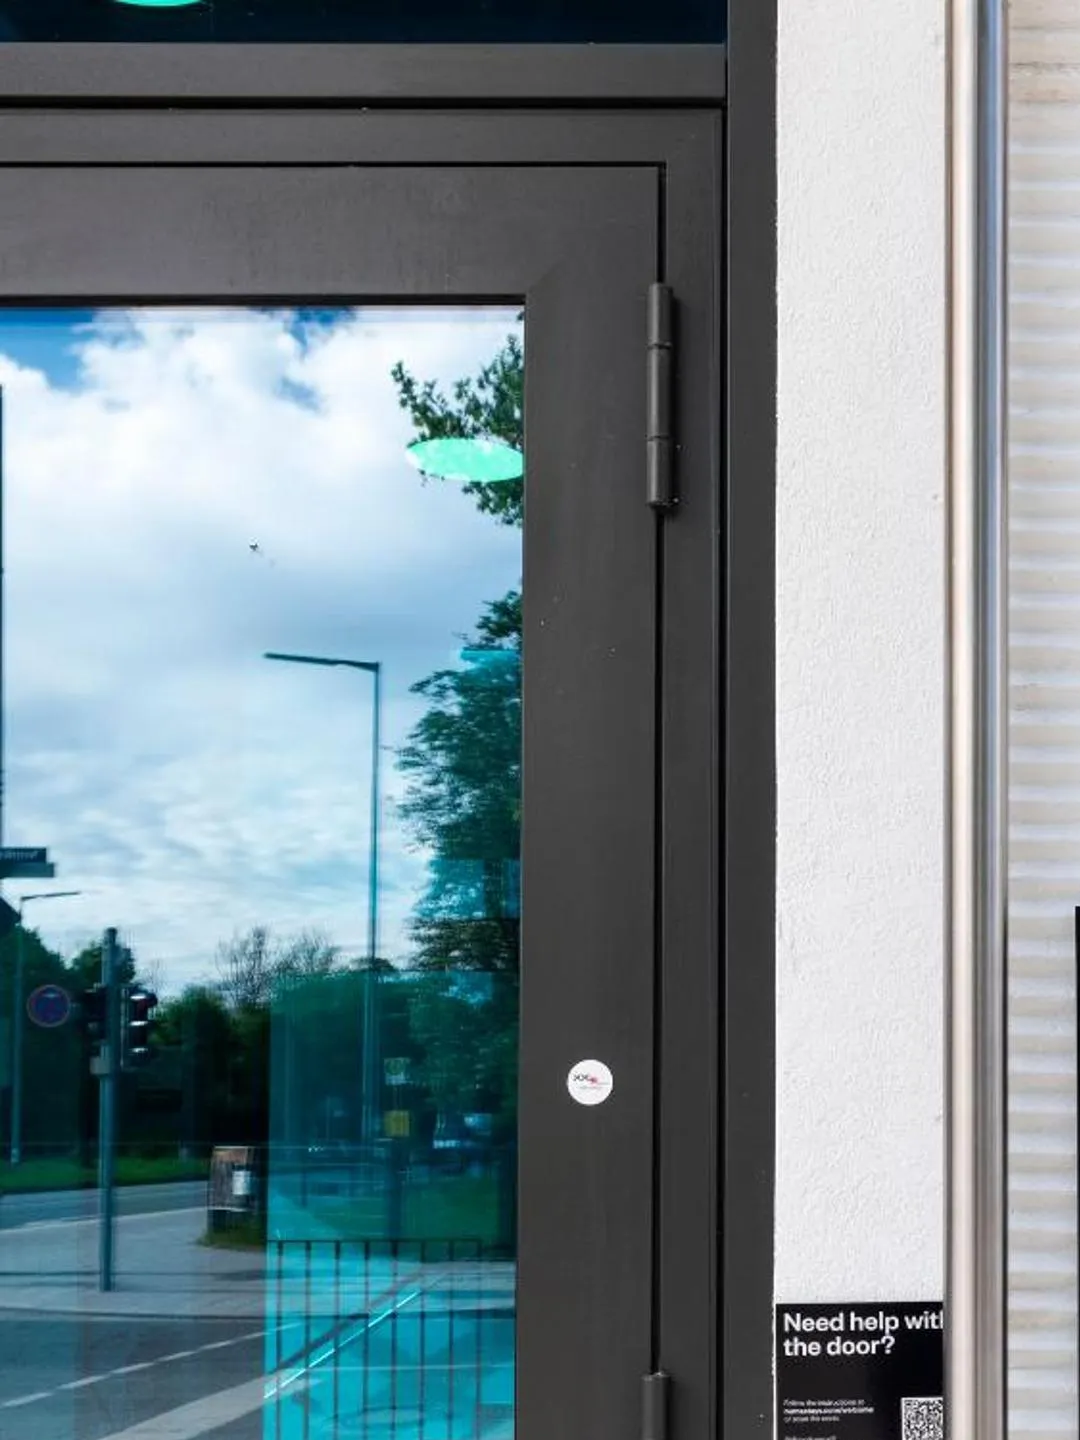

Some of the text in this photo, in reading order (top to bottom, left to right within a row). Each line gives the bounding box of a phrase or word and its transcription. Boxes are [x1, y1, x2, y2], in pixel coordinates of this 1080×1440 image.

[783, 1312, 844, 1332] Need
[850, 1311, 899, 1335] help
[783, 1335, 895, 1356] the door?
